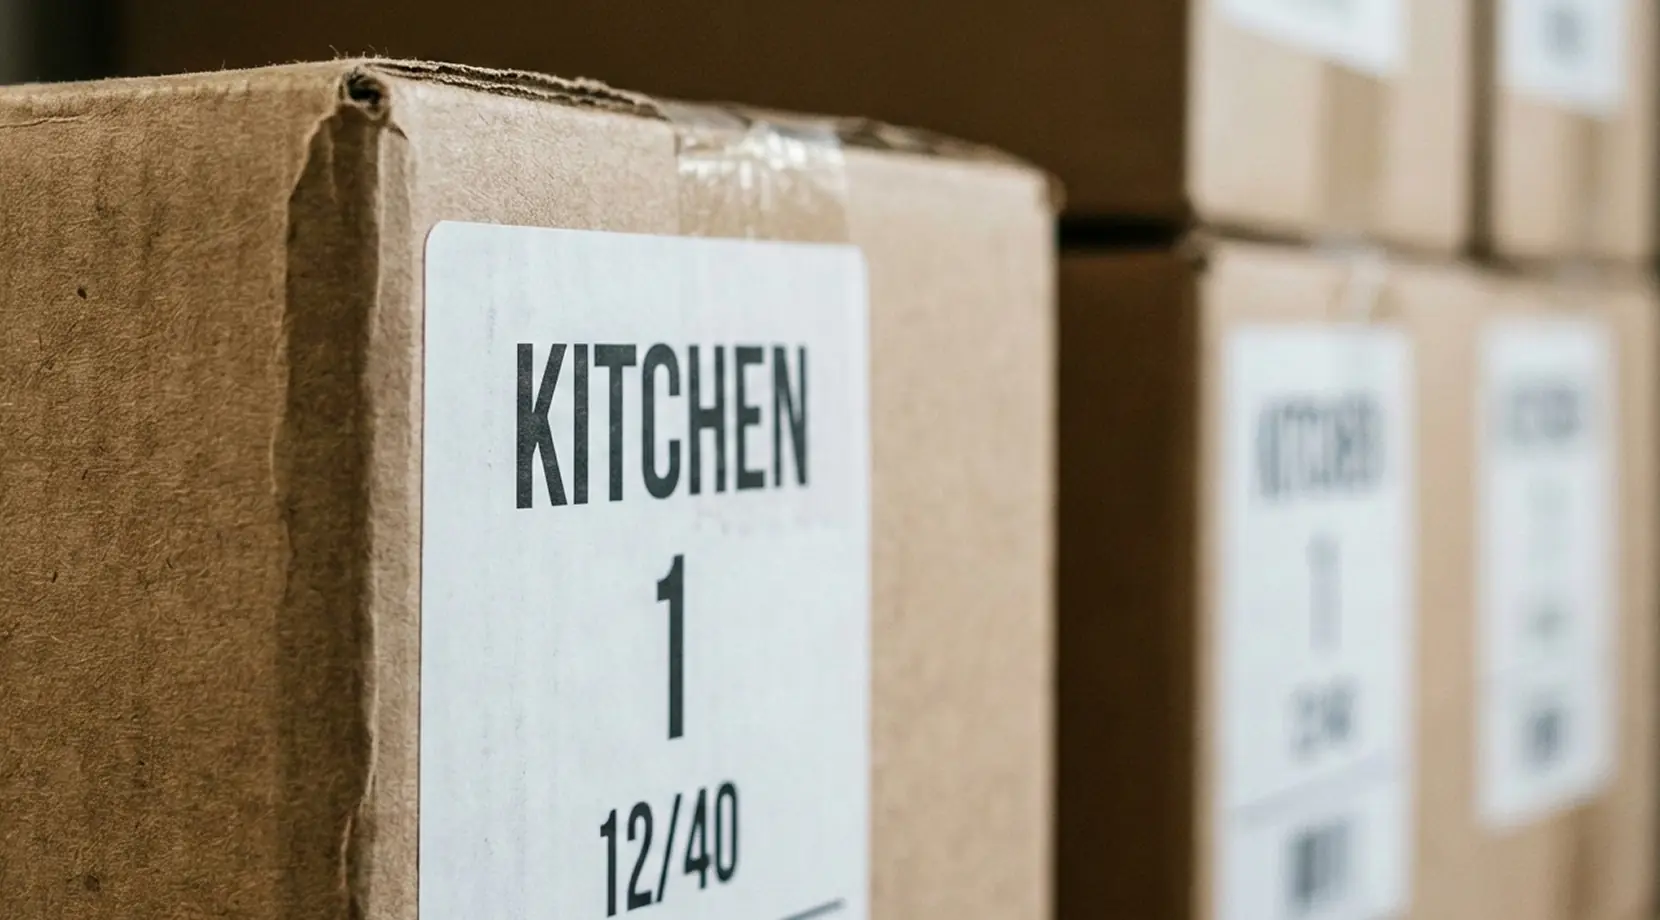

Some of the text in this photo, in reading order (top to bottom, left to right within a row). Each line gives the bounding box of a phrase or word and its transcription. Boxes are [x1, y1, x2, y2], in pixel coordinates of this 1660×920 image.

[515, 342, 808, 510] KITCHEN
[656, 553, 685, 740] 1
[599, 781, 739, 918] 12/40
